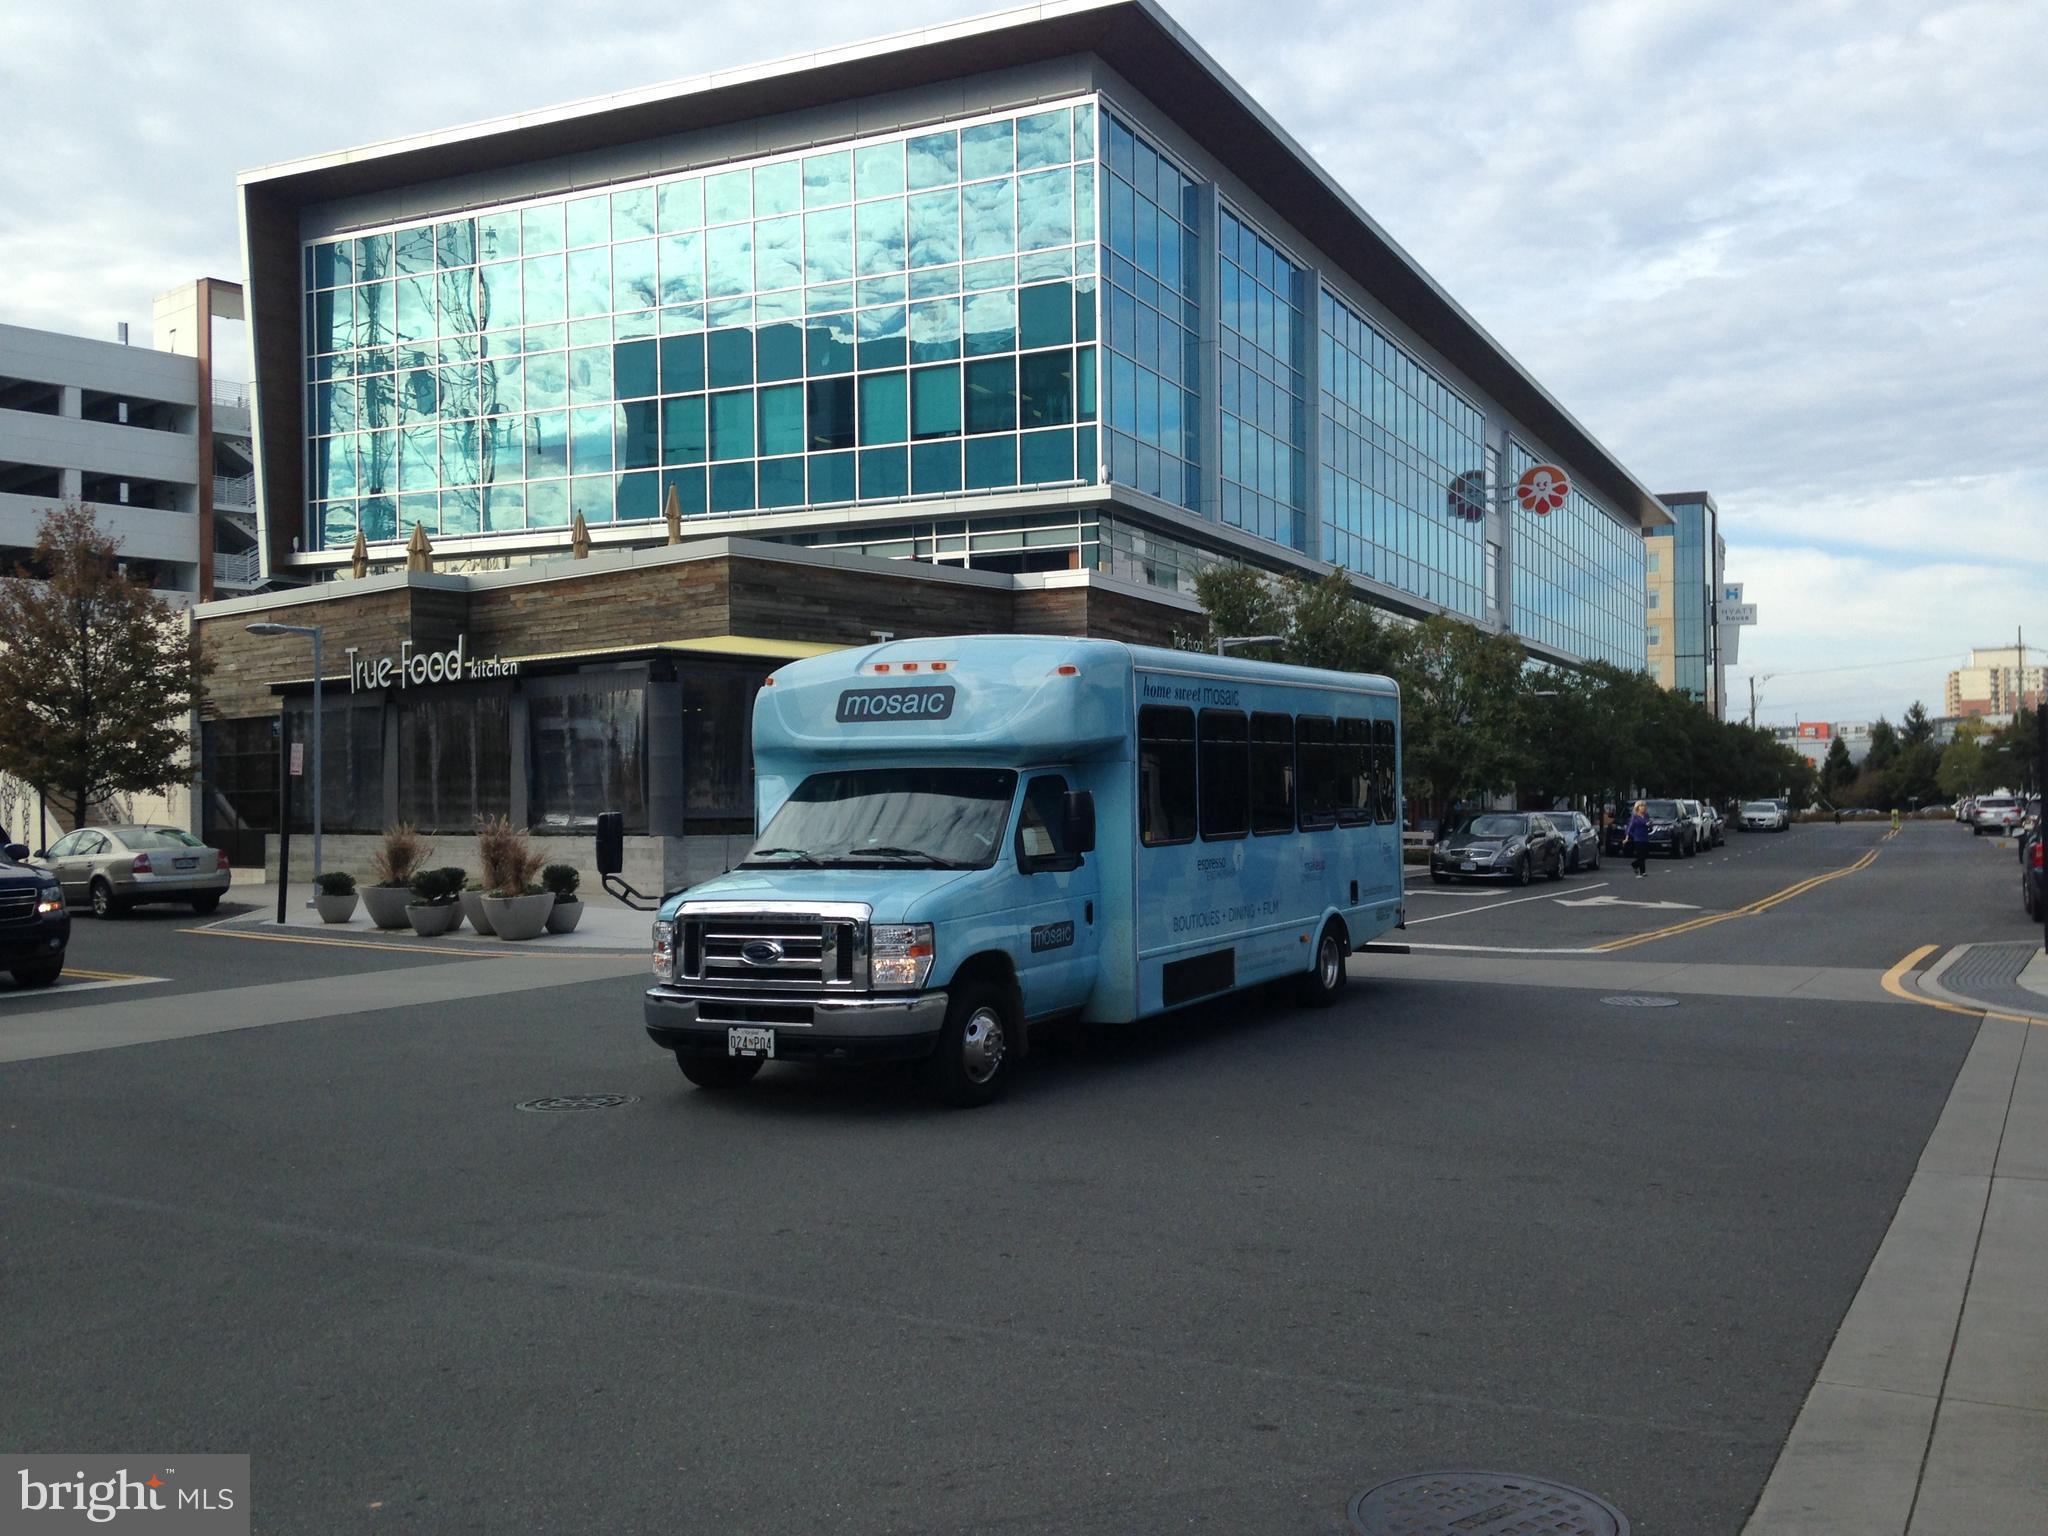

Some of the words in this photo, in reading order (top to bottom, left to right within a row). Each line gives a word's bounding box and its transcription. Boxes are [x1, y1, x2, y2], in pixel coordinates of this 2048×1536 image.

[1721, 607, 1753, 615] HYATT
[345, 647, 392, 694] True
[401, 633, 463, 689] Food
[471, 654, 518, 679] kitchen
[1143, 676, 1172, 699] home
[1203, 687, 1239, 706] mosaic
[843, 692, 945, 716] mosaic
[1034, 926, 1072, 948] mosaic
